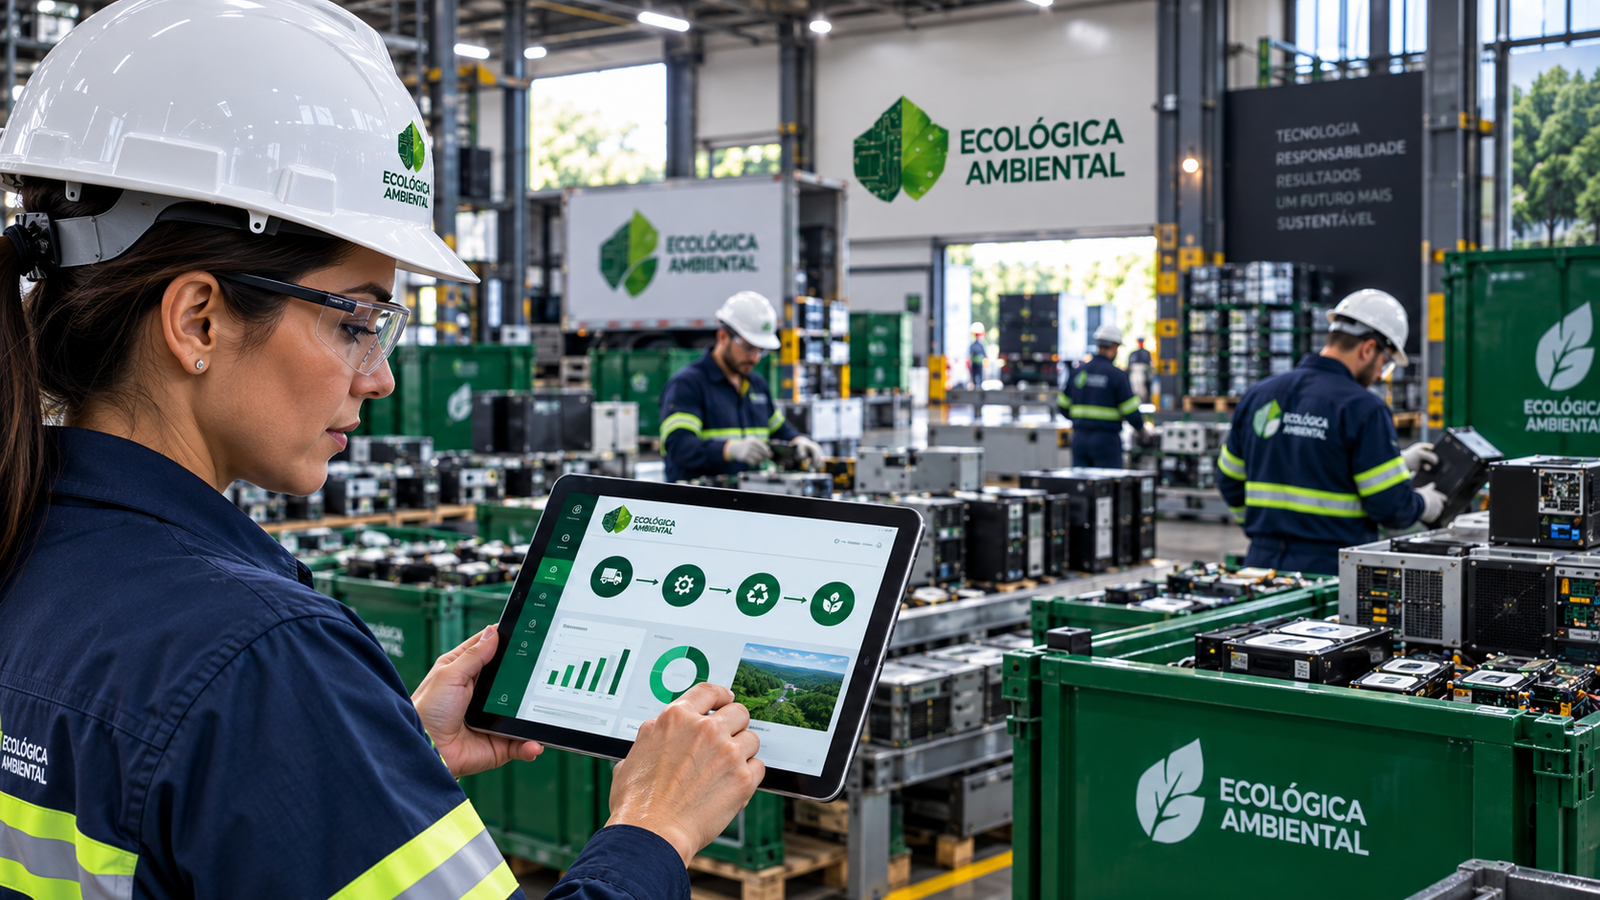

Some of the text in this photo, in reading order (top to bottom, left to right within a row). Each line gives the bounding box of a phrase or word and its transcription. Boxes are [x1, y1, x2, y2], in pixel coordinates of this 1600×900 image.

[960, 116, 1124, 155] ECOLÓGICA
[1276, 122, 1360, 143] TECNOLOGIA
[1276, 139, 1406, 166] RESPONSABILIDADE
[965, 152, 1126, 186] AMBIENTAL
[1276, 167, 1361, 188] RESULTADOS
[382, 170, 431, 196] ECOLÓGICA
[383, 187, 429, 209] AMBIENTAL
[1276, 187, 1393, 210] UM FUTURO MAIS
[1276, 209, 1377, 231] SUSTENTÁVEL
[665, 229, 759, 254] ECOLÓGICA
[667, 253, 760, 275] AMBIENTAL
[632, 524, 673, 535] AMBIENTAL
[633, 515, 676, 528] ECOLÓGICA
[2, 734, 49, 766] ECOLÓGICA
[1, 754, 47, 785] AMBIENTAL
[1220, 777, 1368, 826] ECOLÓGICA
[1220, 807, 1370, 856] AMBIENTAL
